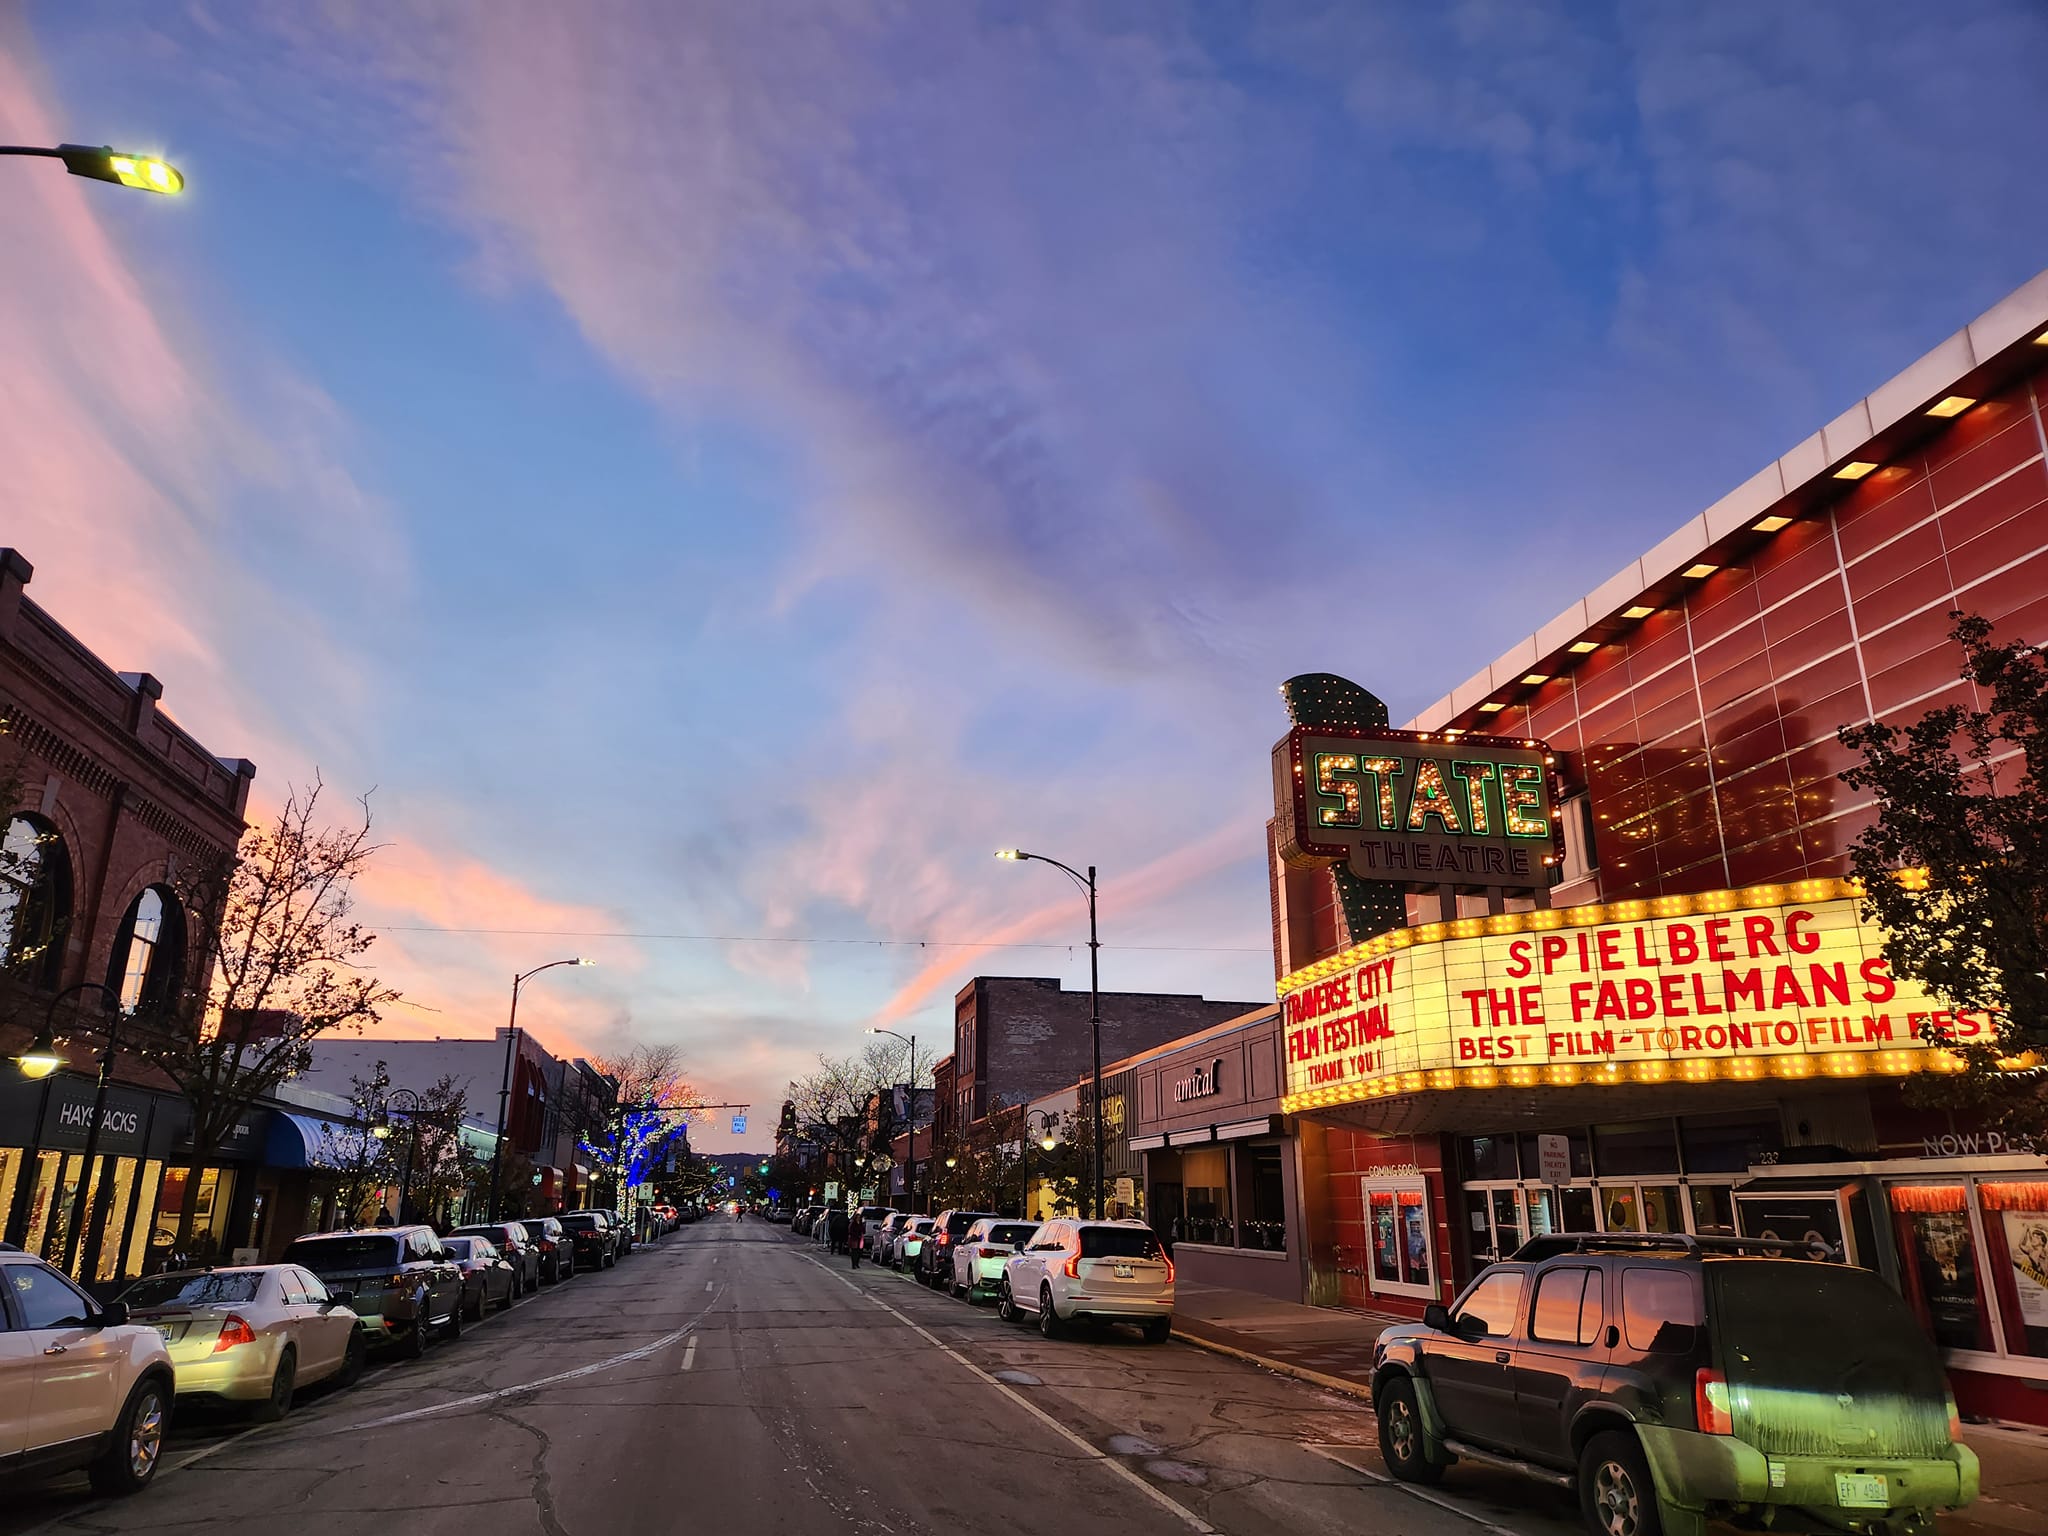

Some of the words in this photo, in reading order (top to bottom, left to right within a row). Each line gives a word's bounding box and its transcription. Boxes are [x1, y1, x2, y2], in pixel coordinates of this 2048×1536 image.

[1313, 752, 1549, 838] STATE
[1360, 839, 1531, 876] THEATRE
[1506, 910, 1821, 979] SPIELBERG
[1284, 973, 1353, 1027] TRAVERSE
[1357, 956, 1395, 1002] CITY
[1462, 985, 1546, 1028] THE
[1569, 958, 1896, 1023] FABELMANS
[1288, 1024, 1320, 1064] FILM
[1323, 1003, 1395, 1055] FESTIVAL
[1459, 1034, 1531, 1060] BEST
[1805, 1013, 1894, 1045] FILM
[1173, 1058, 1218, 1103] amical
[1308, 1059, 1344, 1085] THANK
[1922, 1133, 1980, 1157] NOW
[1368, 1164, 1397, 1178] COMING
[1397, 1163, 1420, 1177] SOON
